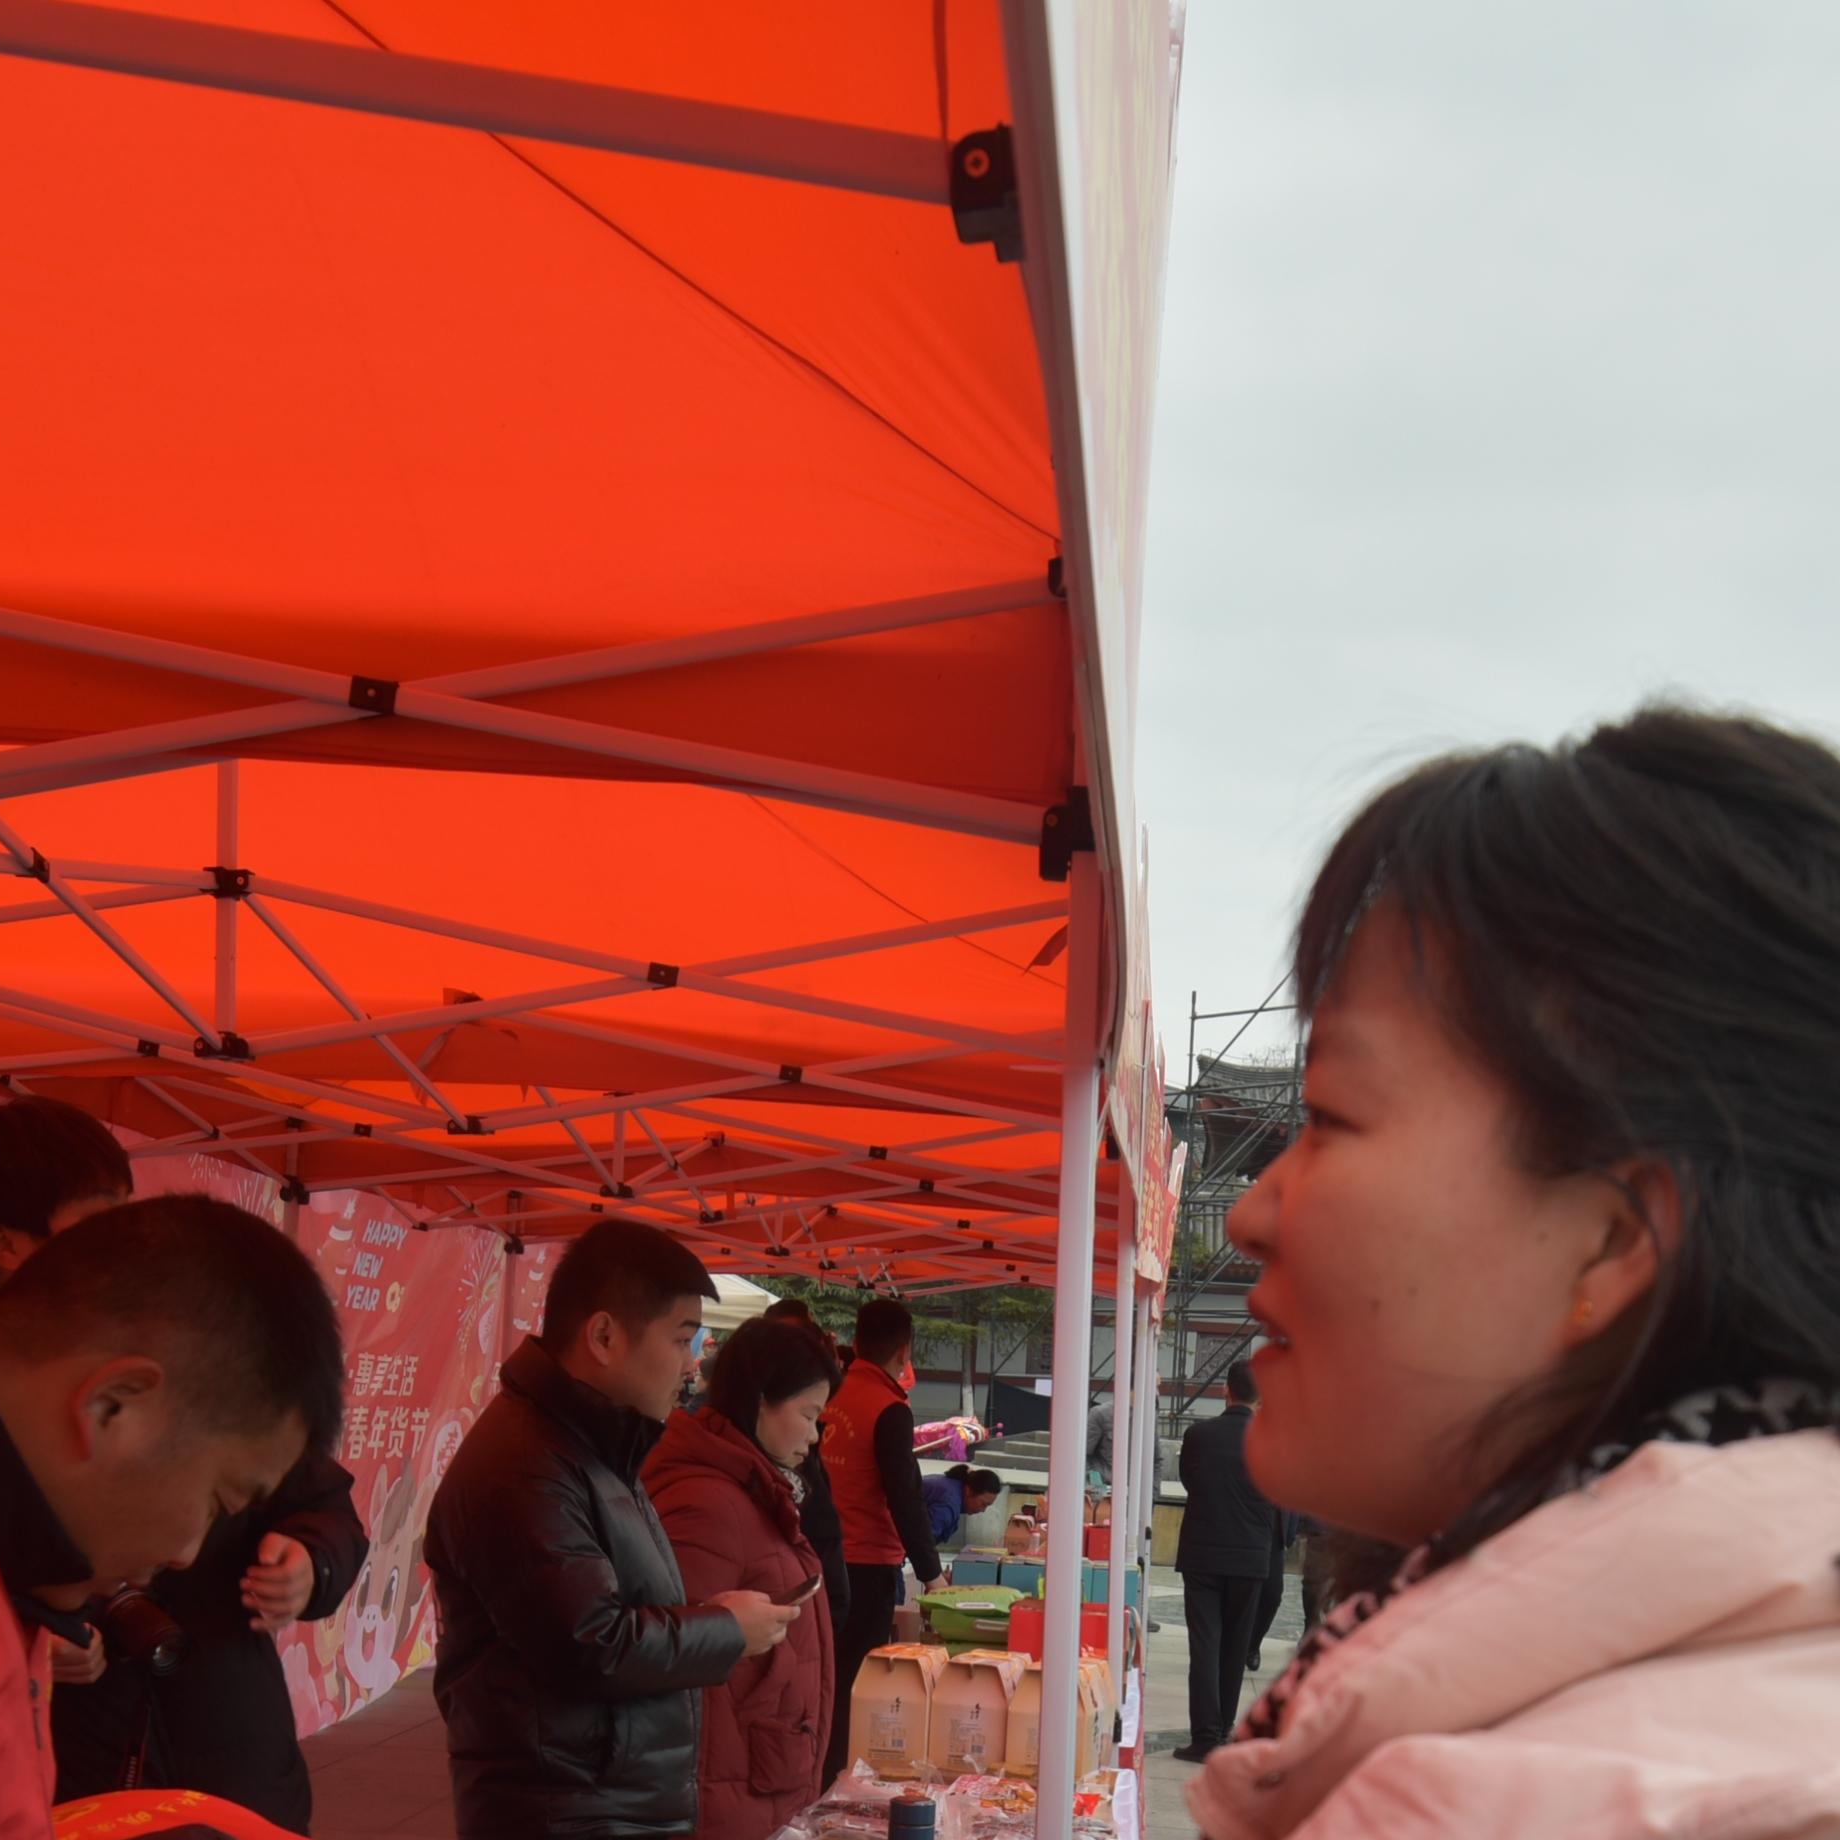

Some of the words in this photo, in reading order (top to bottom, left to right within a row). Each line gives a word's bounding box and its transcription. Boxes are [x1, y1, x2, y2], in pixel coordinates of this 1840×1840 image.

[363, 1219, 408, 1250] HAPPY
[352, 1251, 383, 1278] NEW
[344, 1284, 380, 1311] YEAR
